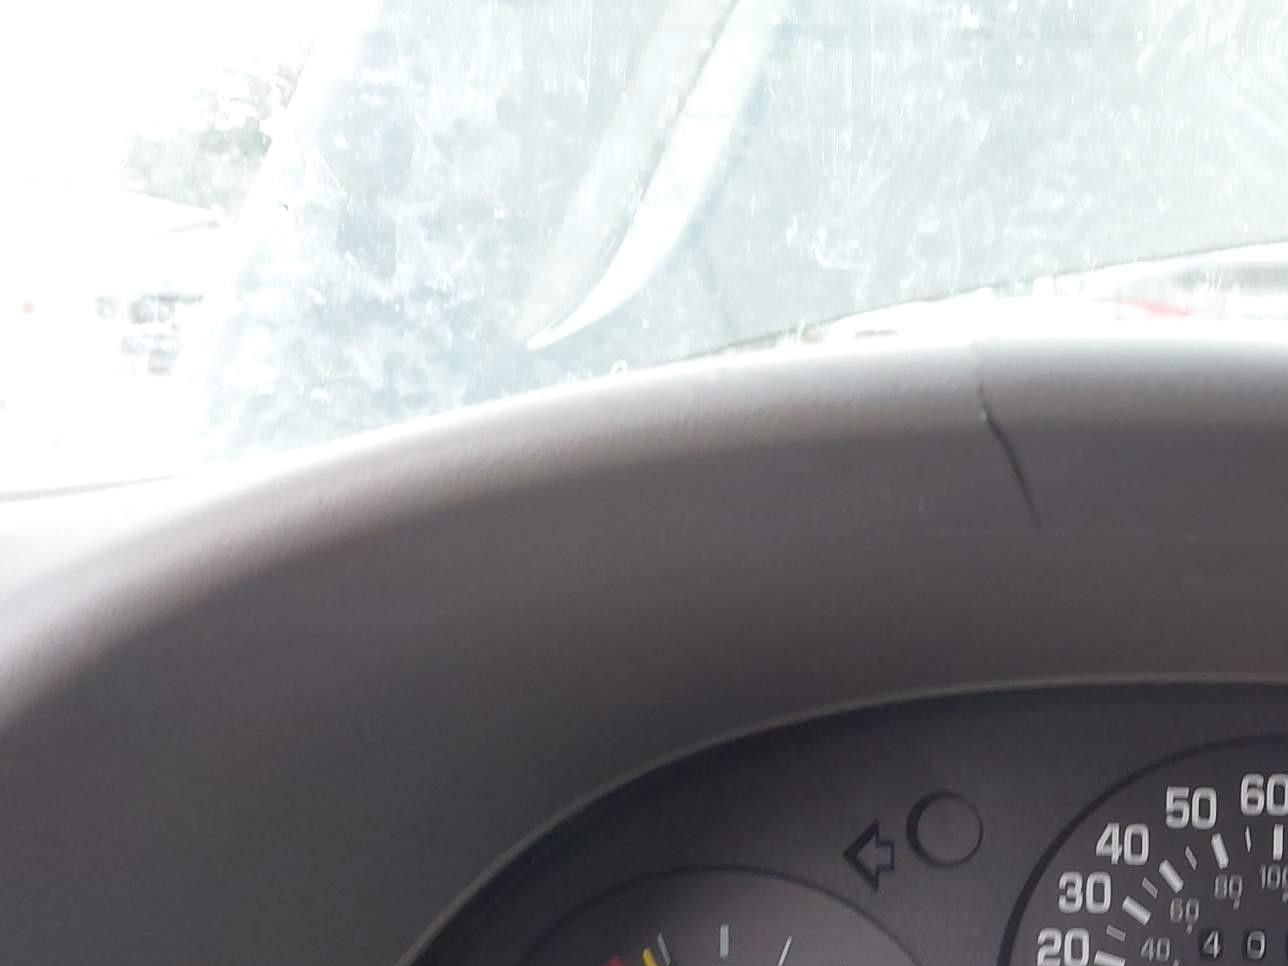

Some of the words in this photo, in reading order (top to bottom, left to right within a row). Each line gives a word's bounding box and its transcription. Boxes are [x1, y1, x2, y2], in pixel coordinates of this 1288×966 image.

[1165, 786, 1217, 830] 50
[1096, 822, 1150, 866] 40
[1058, 871, 1112, 914] 30
[1214, 874, 1243, 900] 80
[1169, 898, 1200, 923] 60
[1140, 936, 1171, 961] 40
